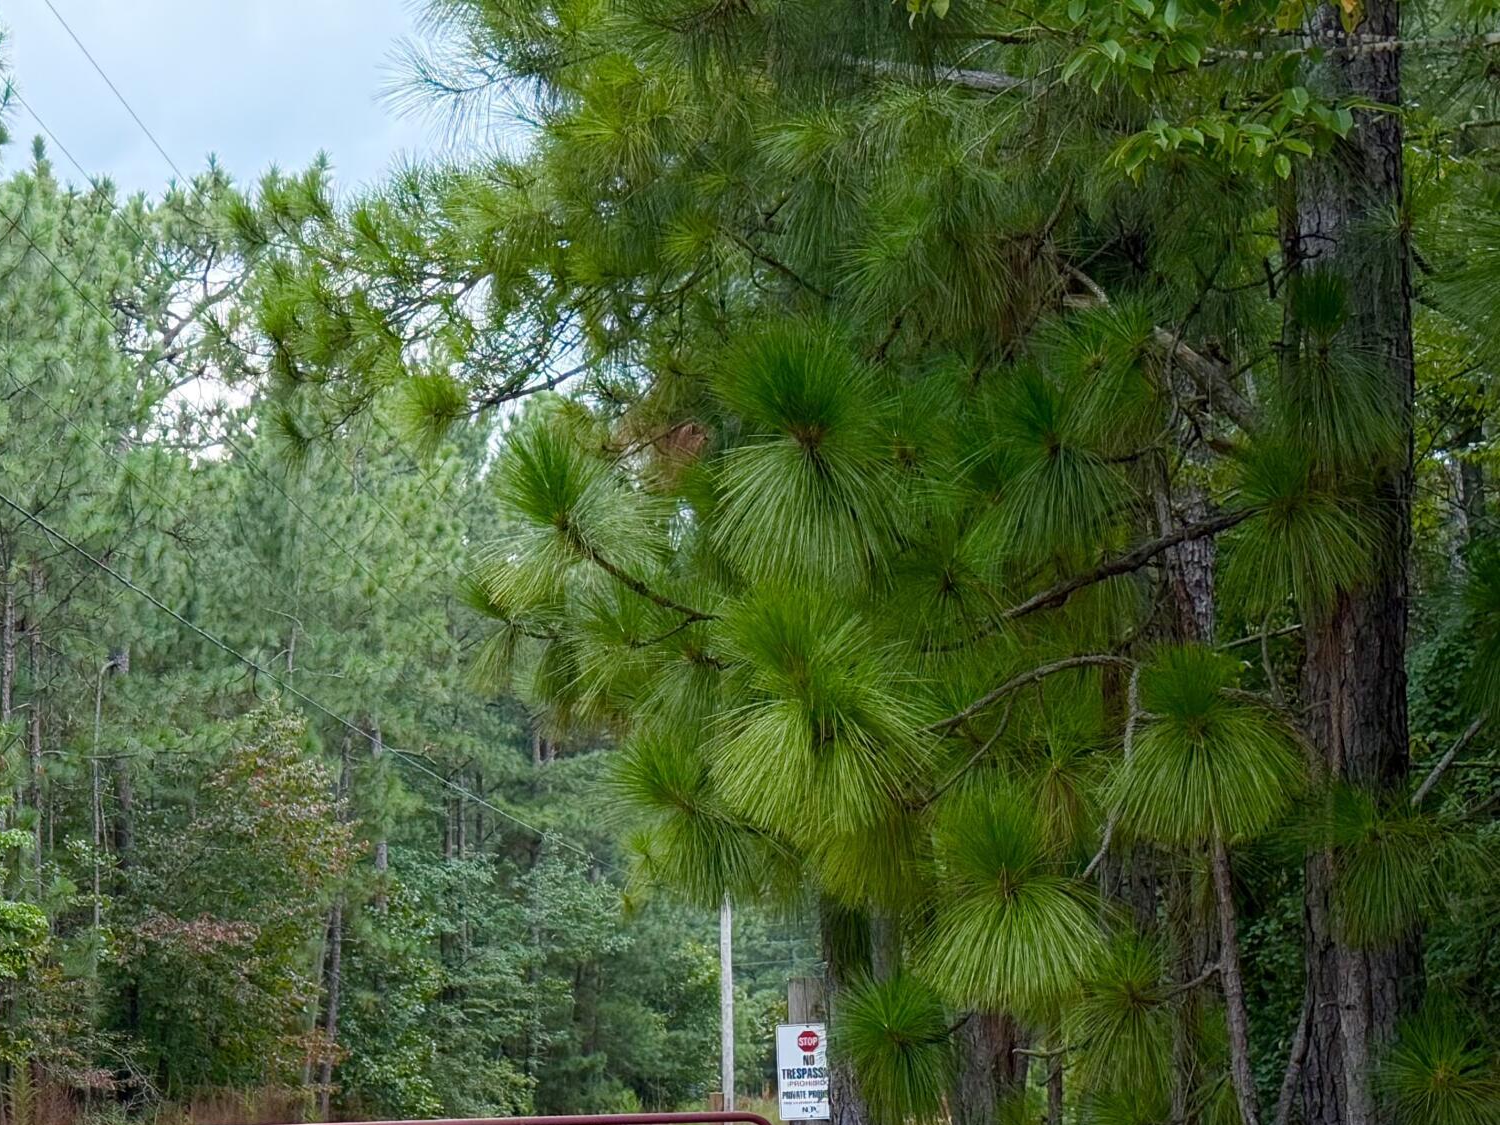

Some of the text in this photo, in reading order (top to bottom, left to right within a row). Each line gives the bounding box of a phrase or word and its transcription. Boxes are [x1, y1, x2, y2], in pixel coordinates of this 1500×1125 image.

[798, 1036, 818, 1047] STOP
[803, 1055, 815, 1066] NO
[781, 1066, 827, 1080] TRESPASS
